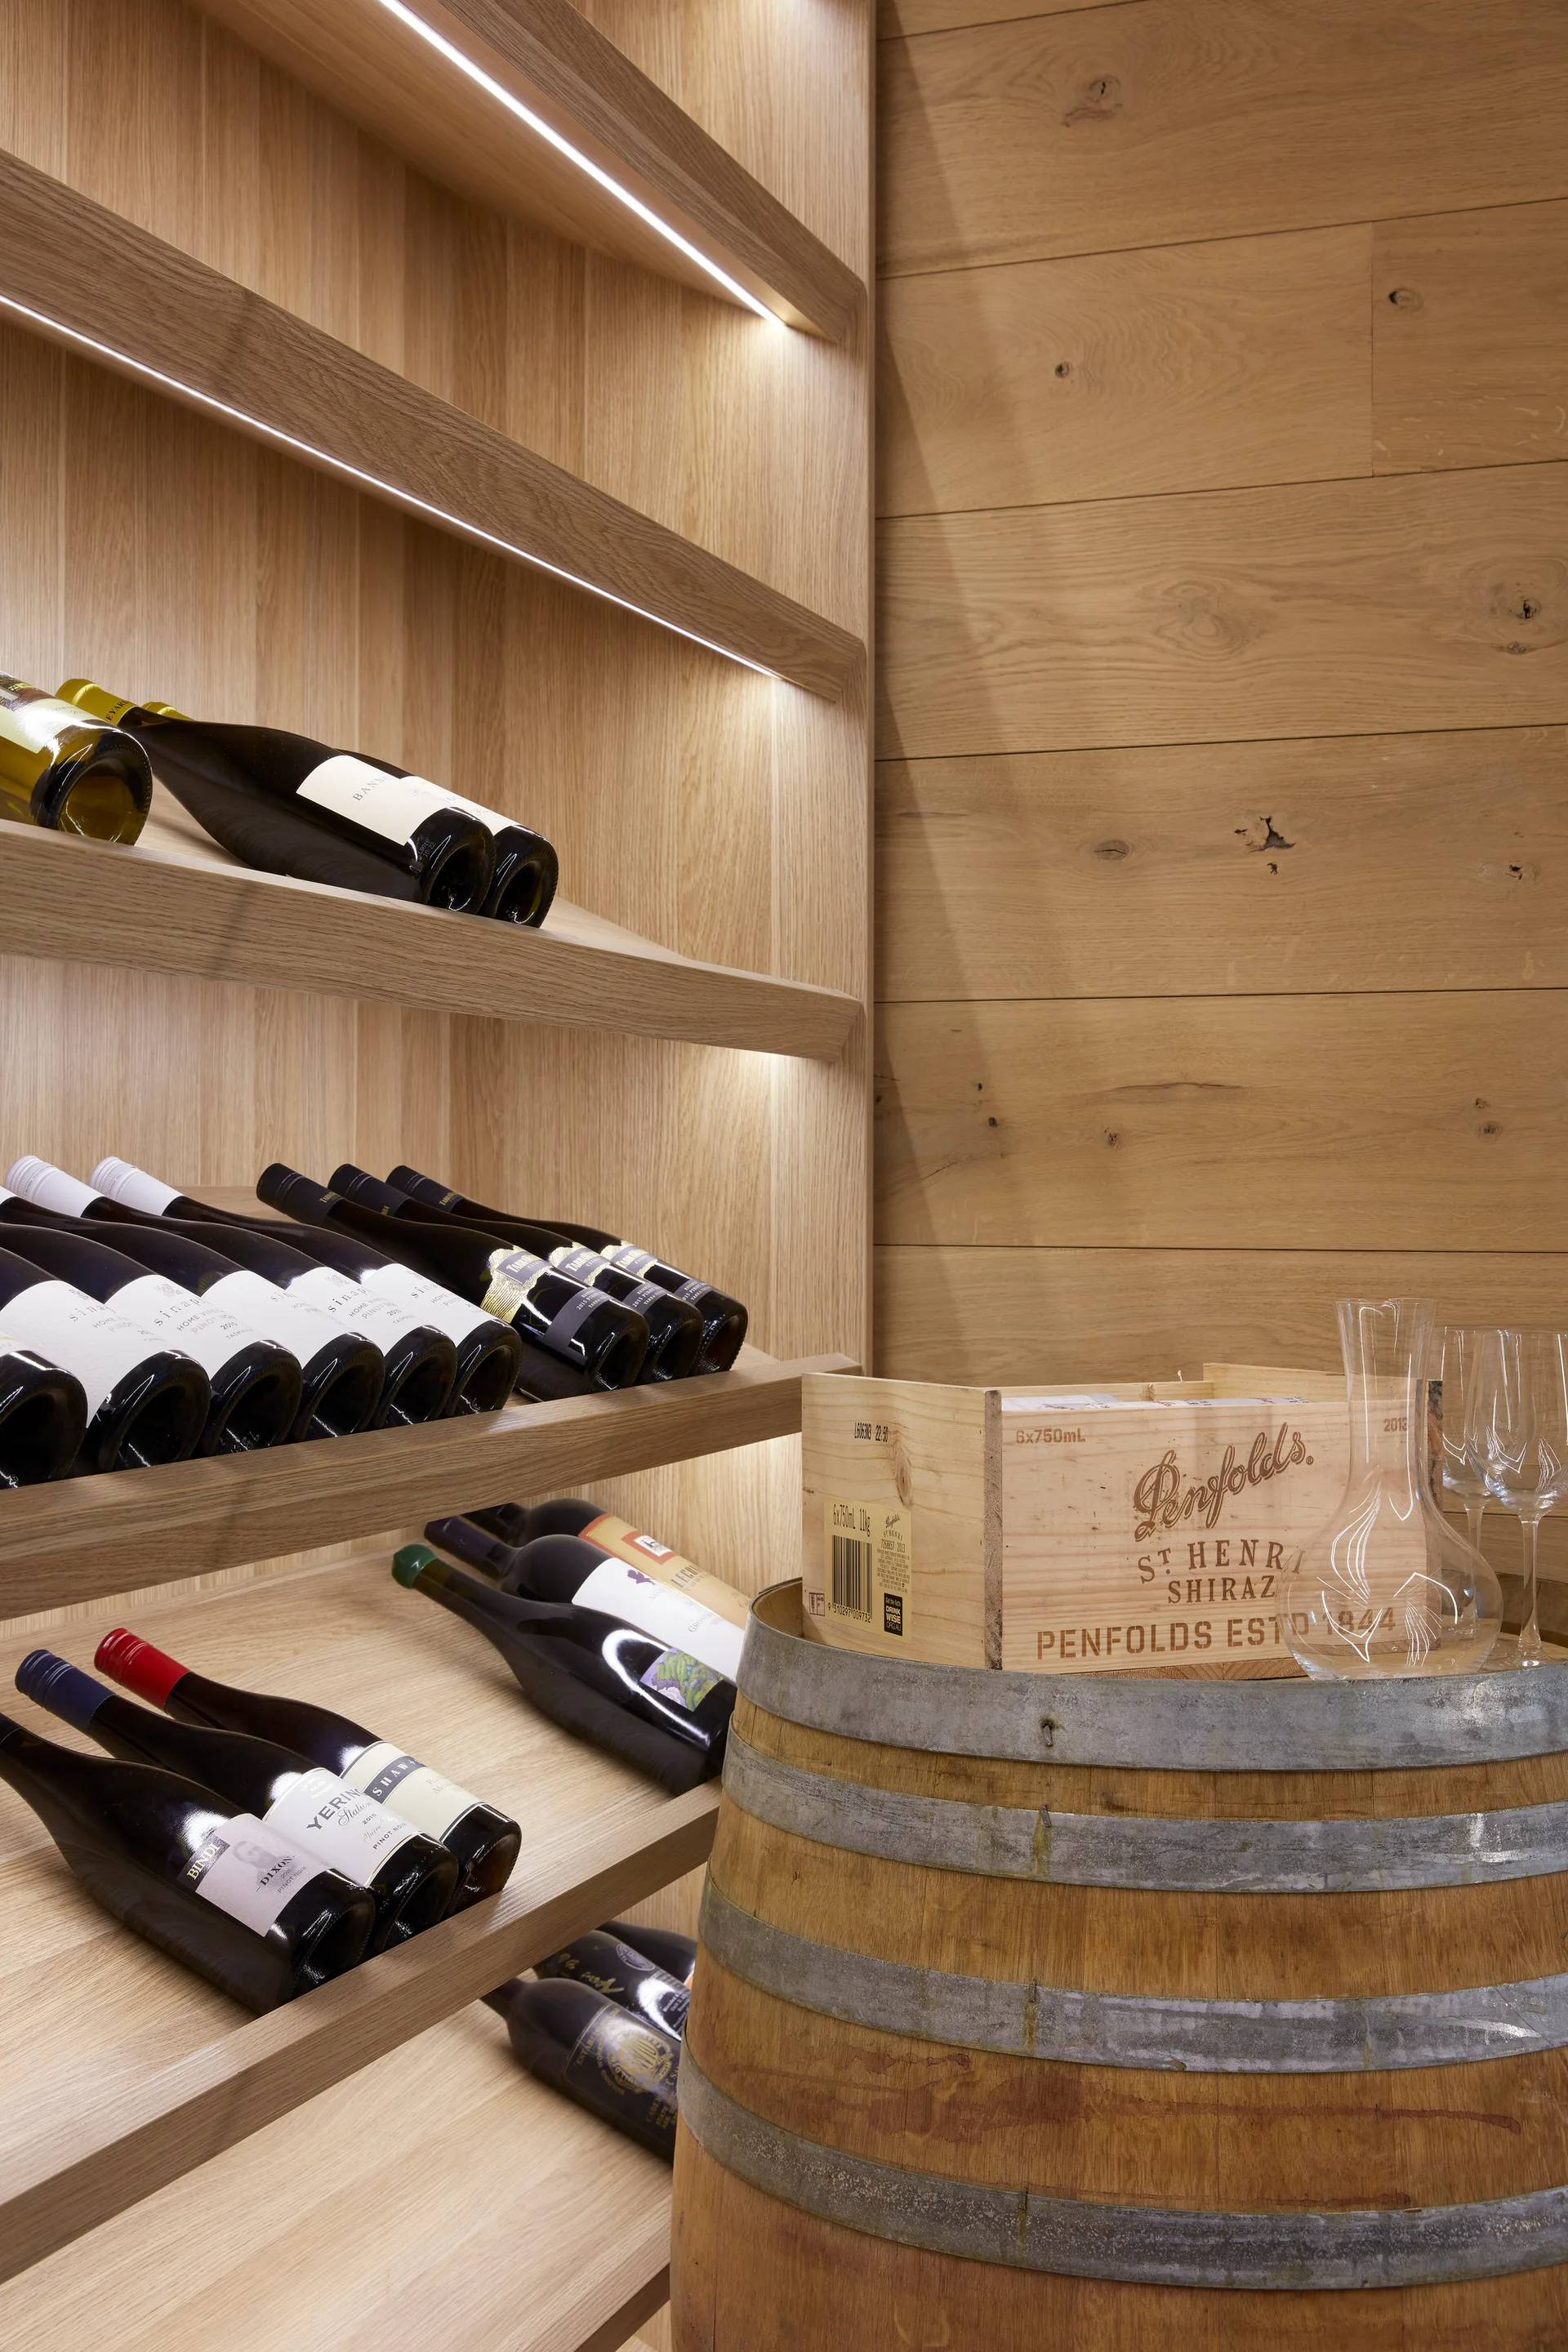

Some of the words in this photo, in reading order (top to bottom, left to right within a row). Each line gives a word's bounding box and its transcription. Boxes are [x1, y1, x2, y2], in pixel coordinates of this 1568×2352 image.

[348, 1302, 368, 1317] HOME
[176, 1314, 201, 1332] HOME
[1383, 1417, 1407, 1432] 2013
[1016, 1428, 1086, 1445] 6x750mL
[833, 1503, 856, 1530] 6x750mL
[859, 1508, 871, 1537] 11kg
[1168, 1575, 1276, 1605] SHIRAZ
[885, 1606, 901, 1615] DRINK
[885, 1612, 902, 1624] WISE
[1036, 1619, 1213, 1660] PENFOLDS
[372, 1762, 409, 1797] SHAW
[362, 1812, 377, 1825] 2015
[372, 1830, 394, 1851] PINOT
[186, 1842, 220, 1881] BINDI
[259, 1855, 293, 1886] DIXON
[277, 1876, 295, 1894] PINOT
